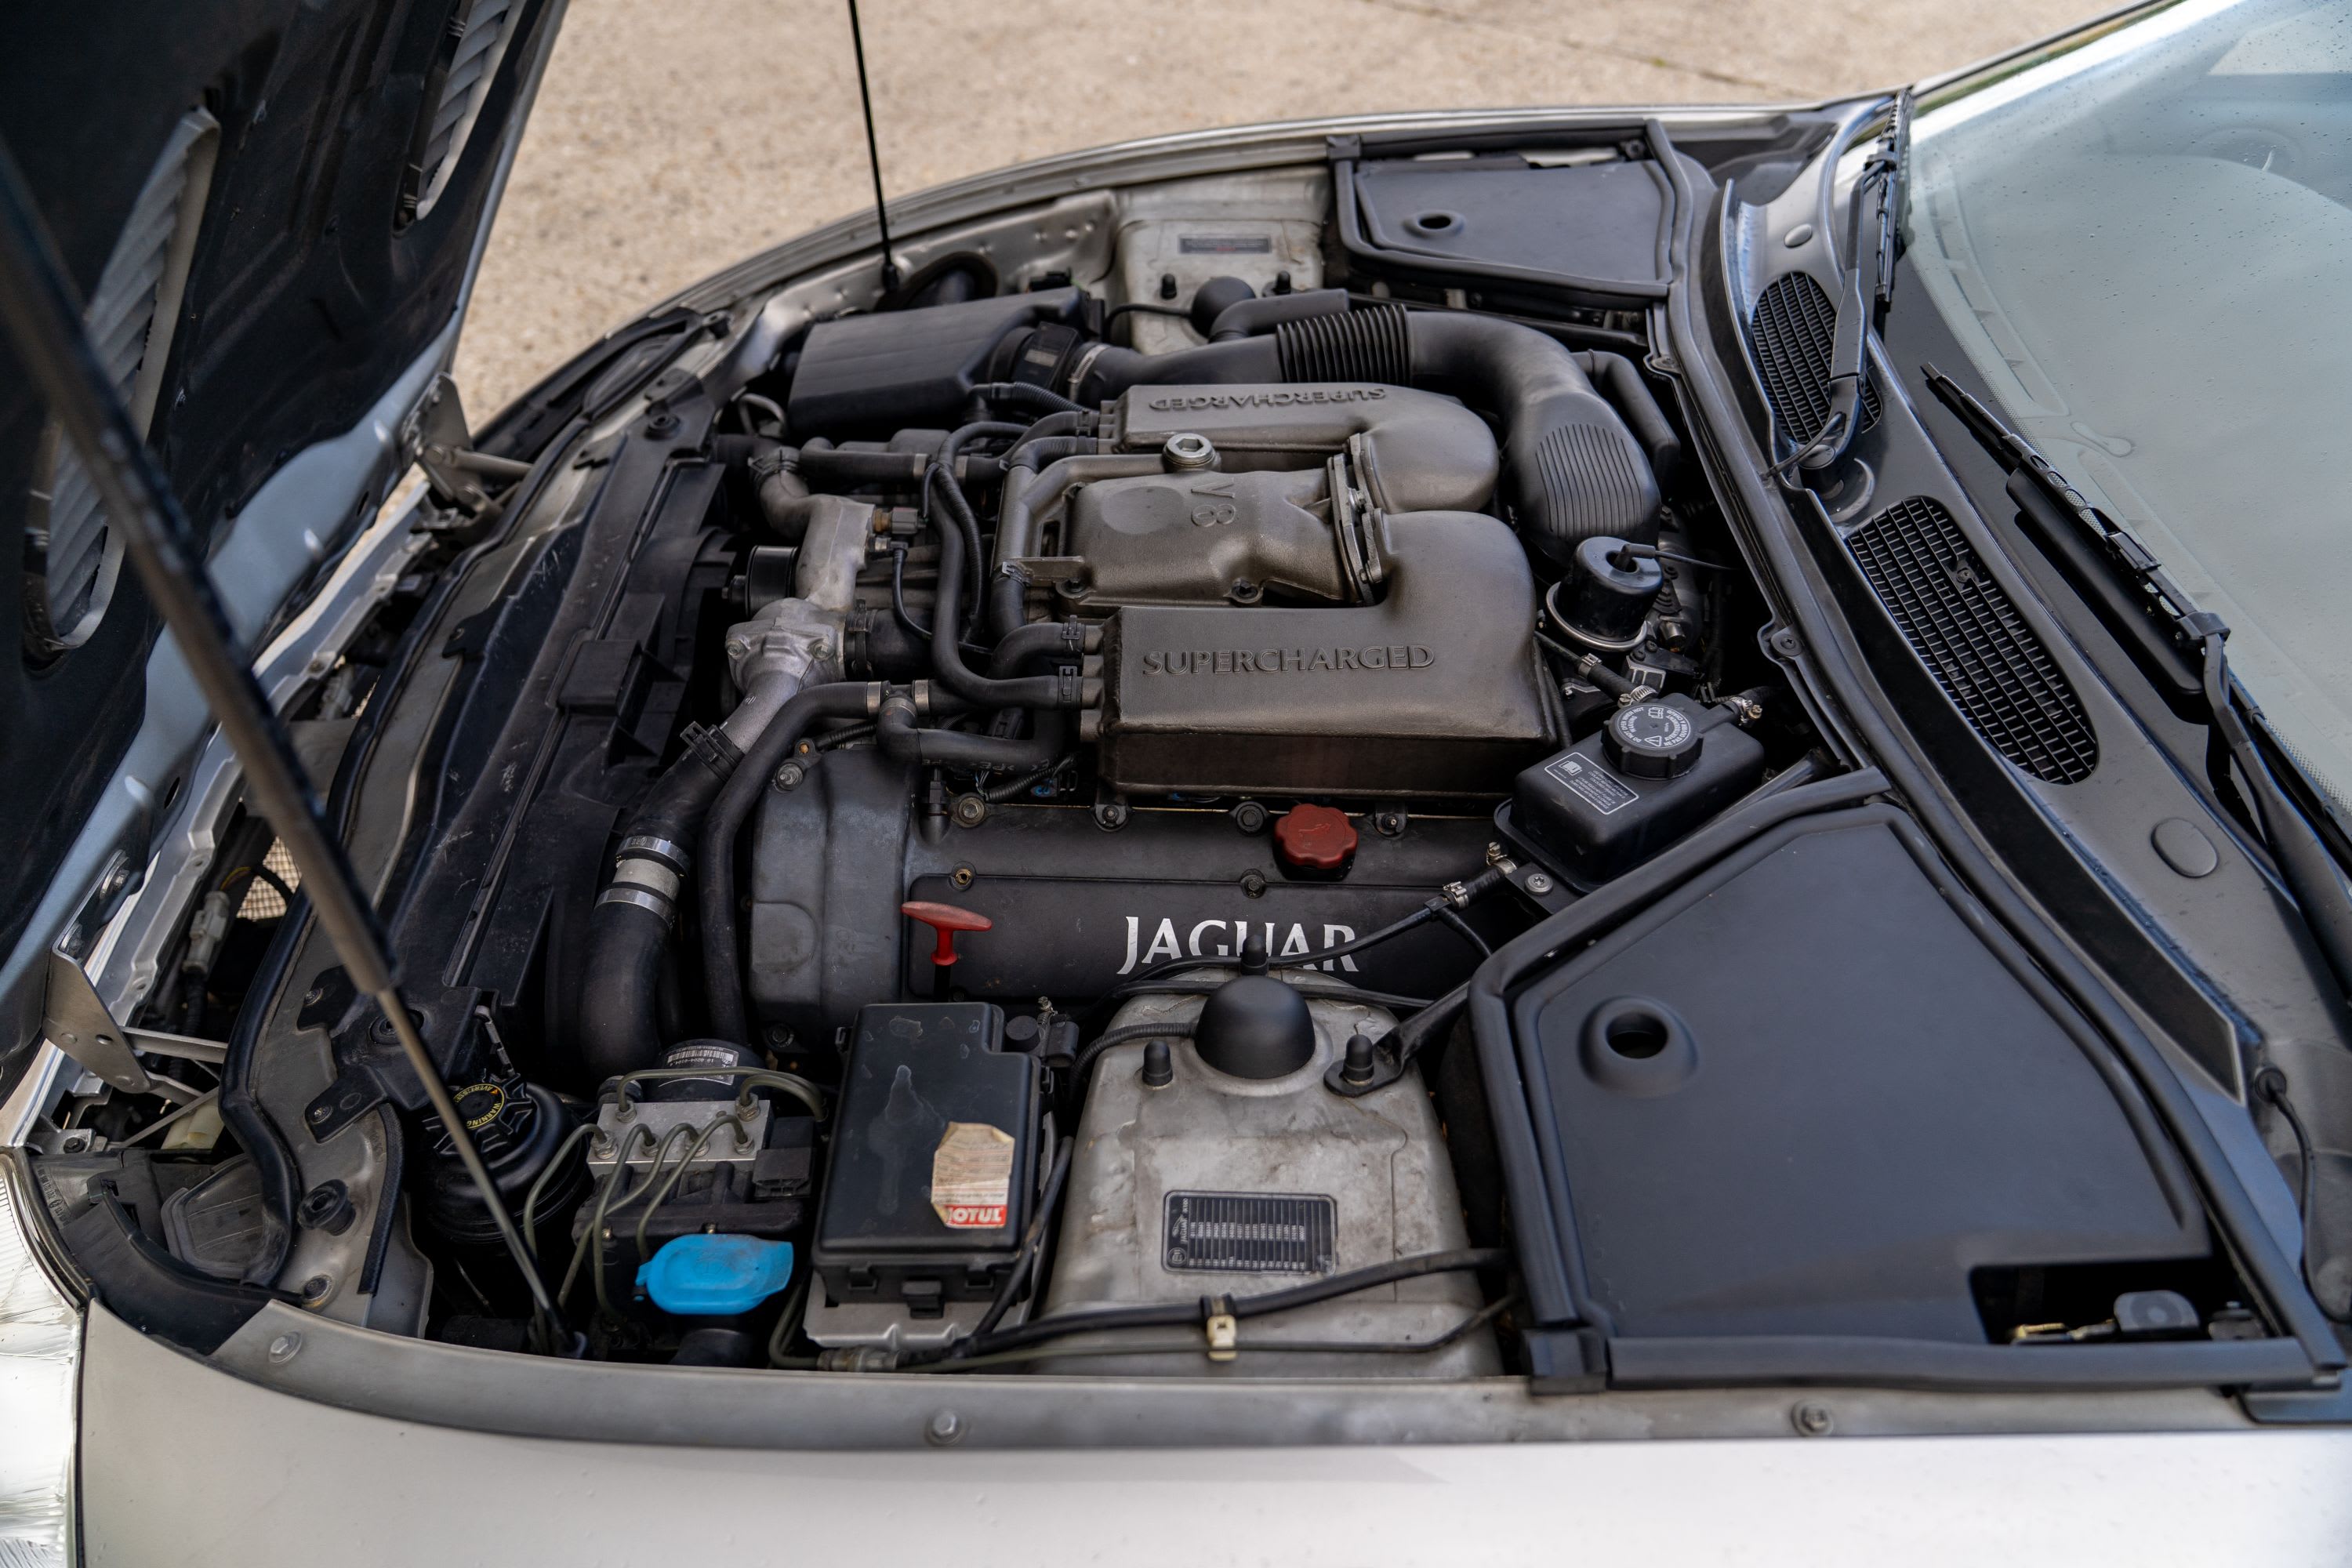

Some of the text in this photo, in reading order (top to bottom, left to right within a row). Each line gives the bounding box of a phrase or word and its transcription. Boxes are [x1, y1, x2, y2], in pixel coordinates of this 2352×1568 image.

[1149, 387, 1387, 411] SUPERCHARGED
[1190, 481, 1236, 527] V8
[1142, 644, 1436, 676] SUPERCHARGED
[1116, 916, 1359, 974] JAGUAR
[466, 1102, 502, 1127] WARNING
